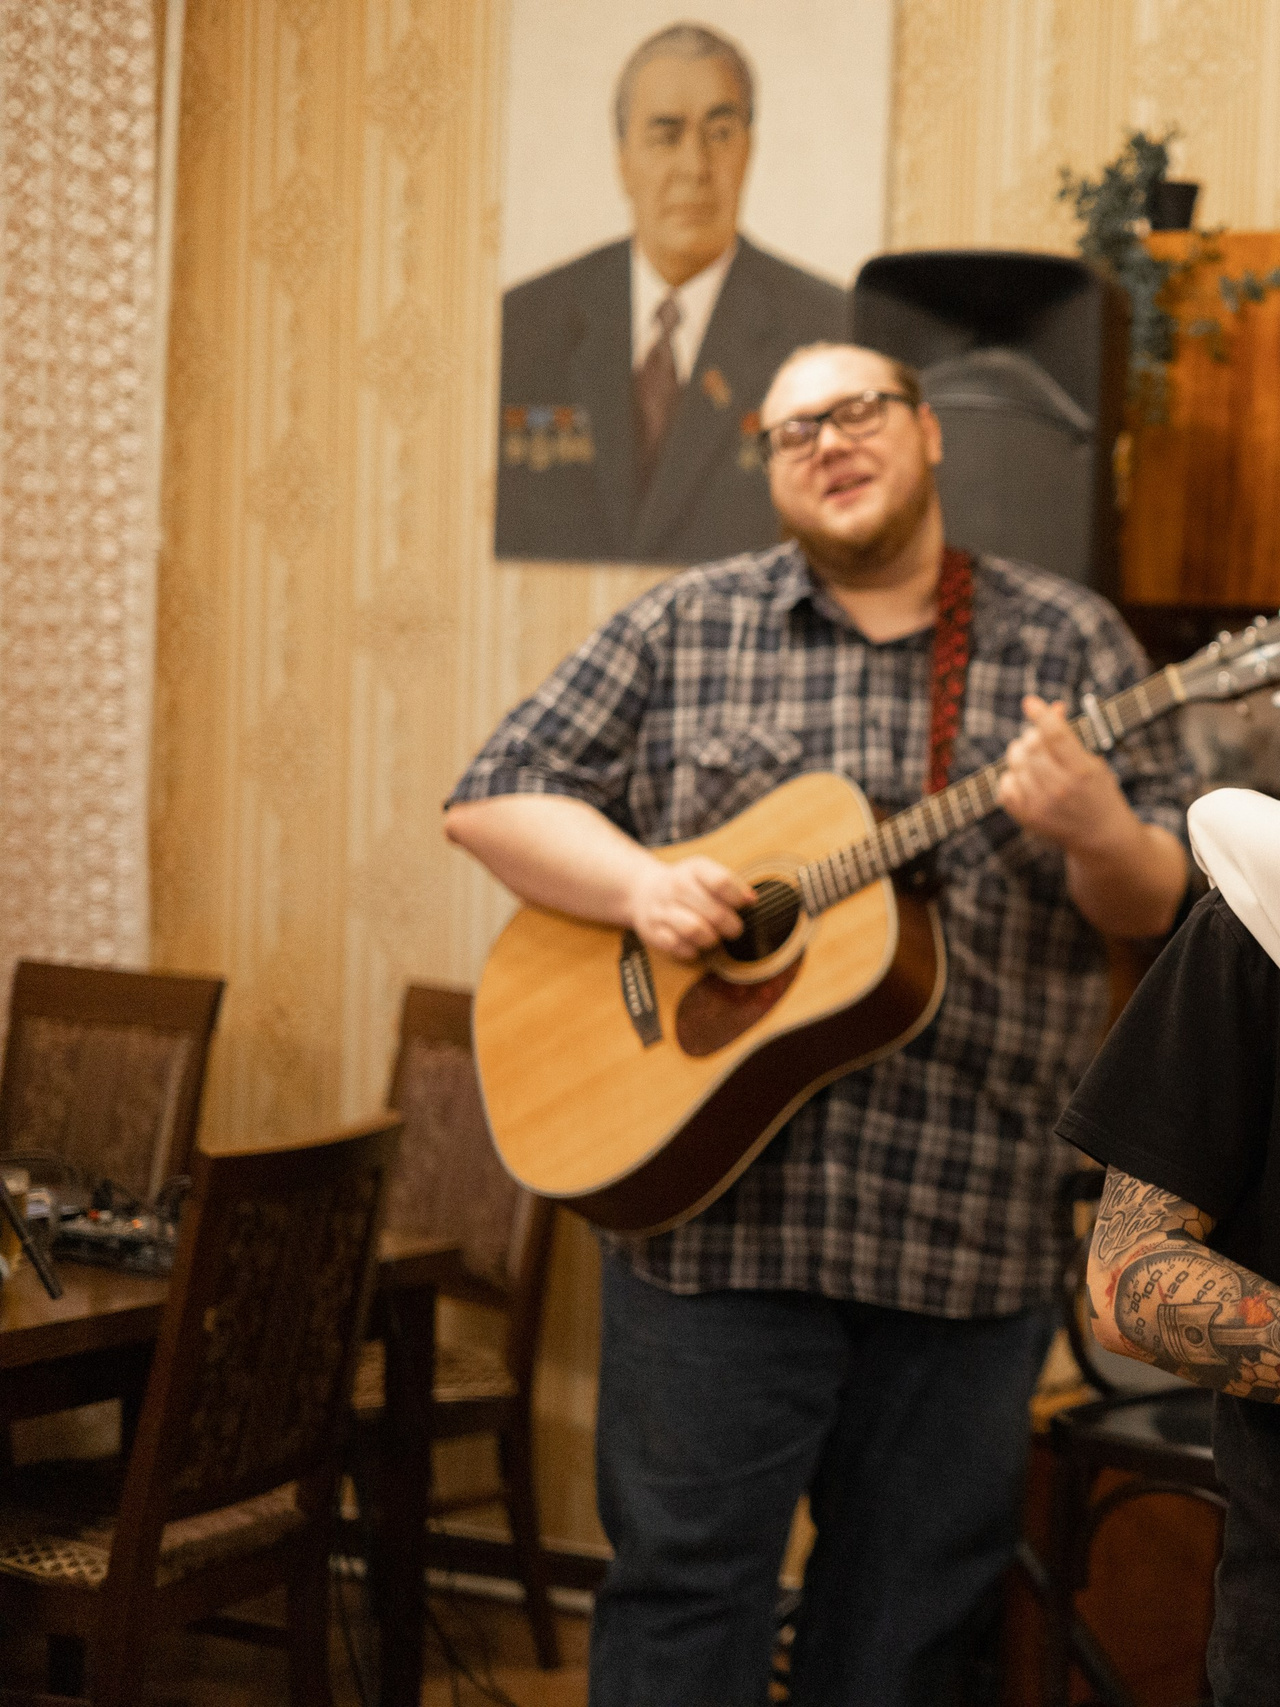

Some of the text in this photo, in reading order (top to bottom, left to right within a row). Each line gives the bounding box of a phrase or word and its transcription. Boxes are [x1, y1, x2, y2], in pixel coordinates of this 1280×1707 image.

[1142, 1269, 1163, 1299] 100
[1164, 1271, 1189, 1299] 120
[1130, 1291, 1142, 1313] 80
